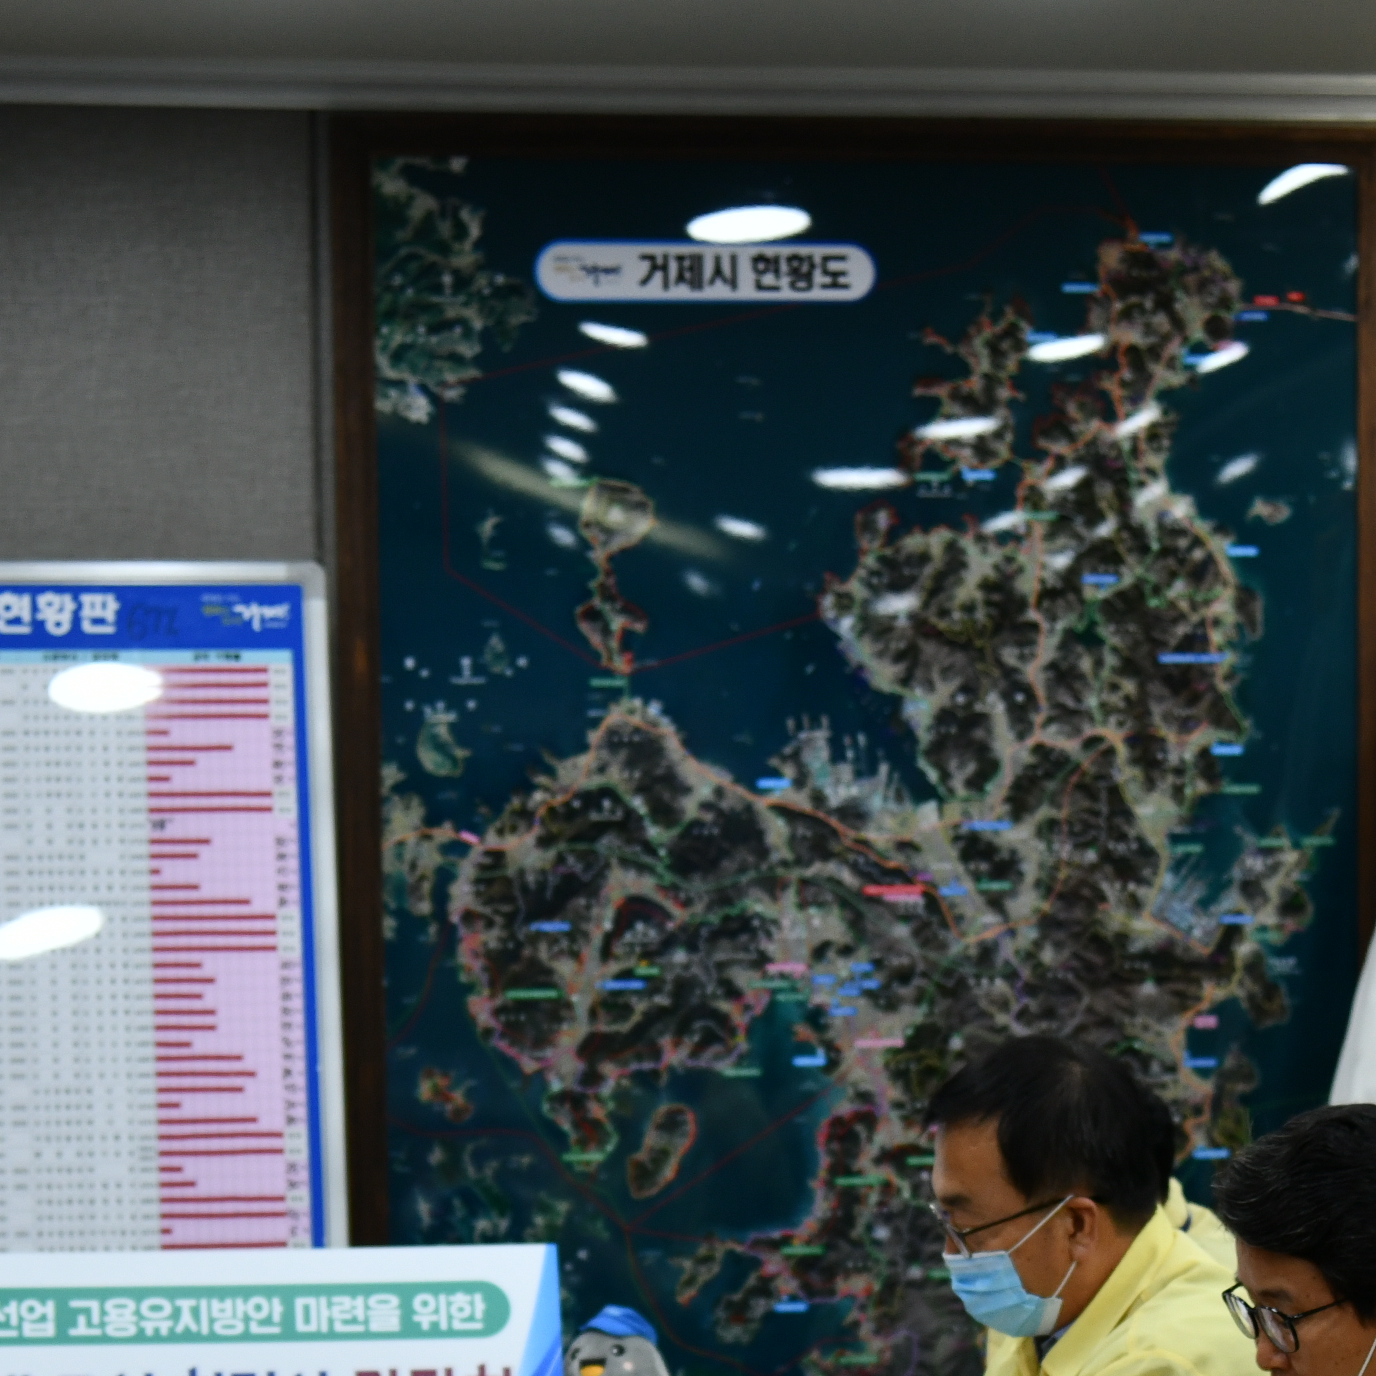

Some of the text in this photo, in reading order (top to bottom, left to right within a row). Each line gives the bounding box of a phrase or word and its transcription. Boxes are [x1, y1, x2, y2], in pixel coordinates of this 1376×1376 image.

[637, 252, 739, 292] 거제시
[749, 252, 852, 292] 현황도
[68, 1294, 283, 1339] 고용유지방안
[294, 1293, 403, 1336] 마련을
[411, 1291, 486, 1333] 위한
